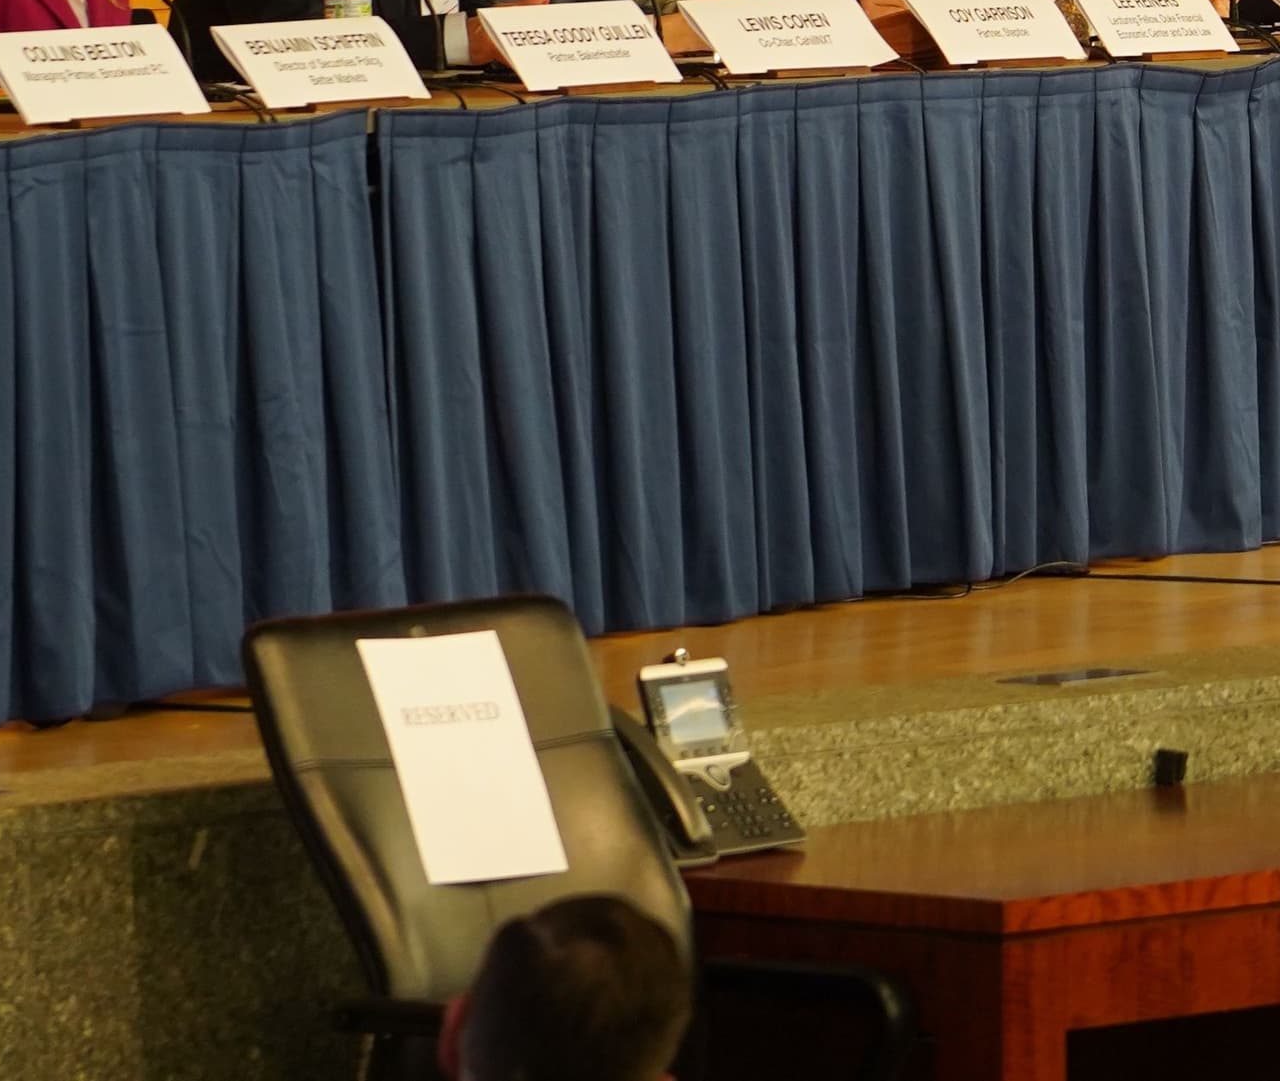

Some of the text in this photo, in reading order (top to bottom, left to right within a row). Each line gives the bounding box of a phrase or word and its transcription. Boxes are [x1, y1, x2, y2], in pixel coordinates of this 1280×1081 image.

[737, 12, 832, 32] LEWIS COHEN
[948, 6, 1035, 23] COY GARRISON
[245, 32, 386, 55] BENJAMIN SCHIFFRIN
[501, 24, 654, 47] TERESA GOODY GUILLEN
[22, 40, 147, 63] COLLINS BELTON
[400, 700, 500, 726] RESERVED
